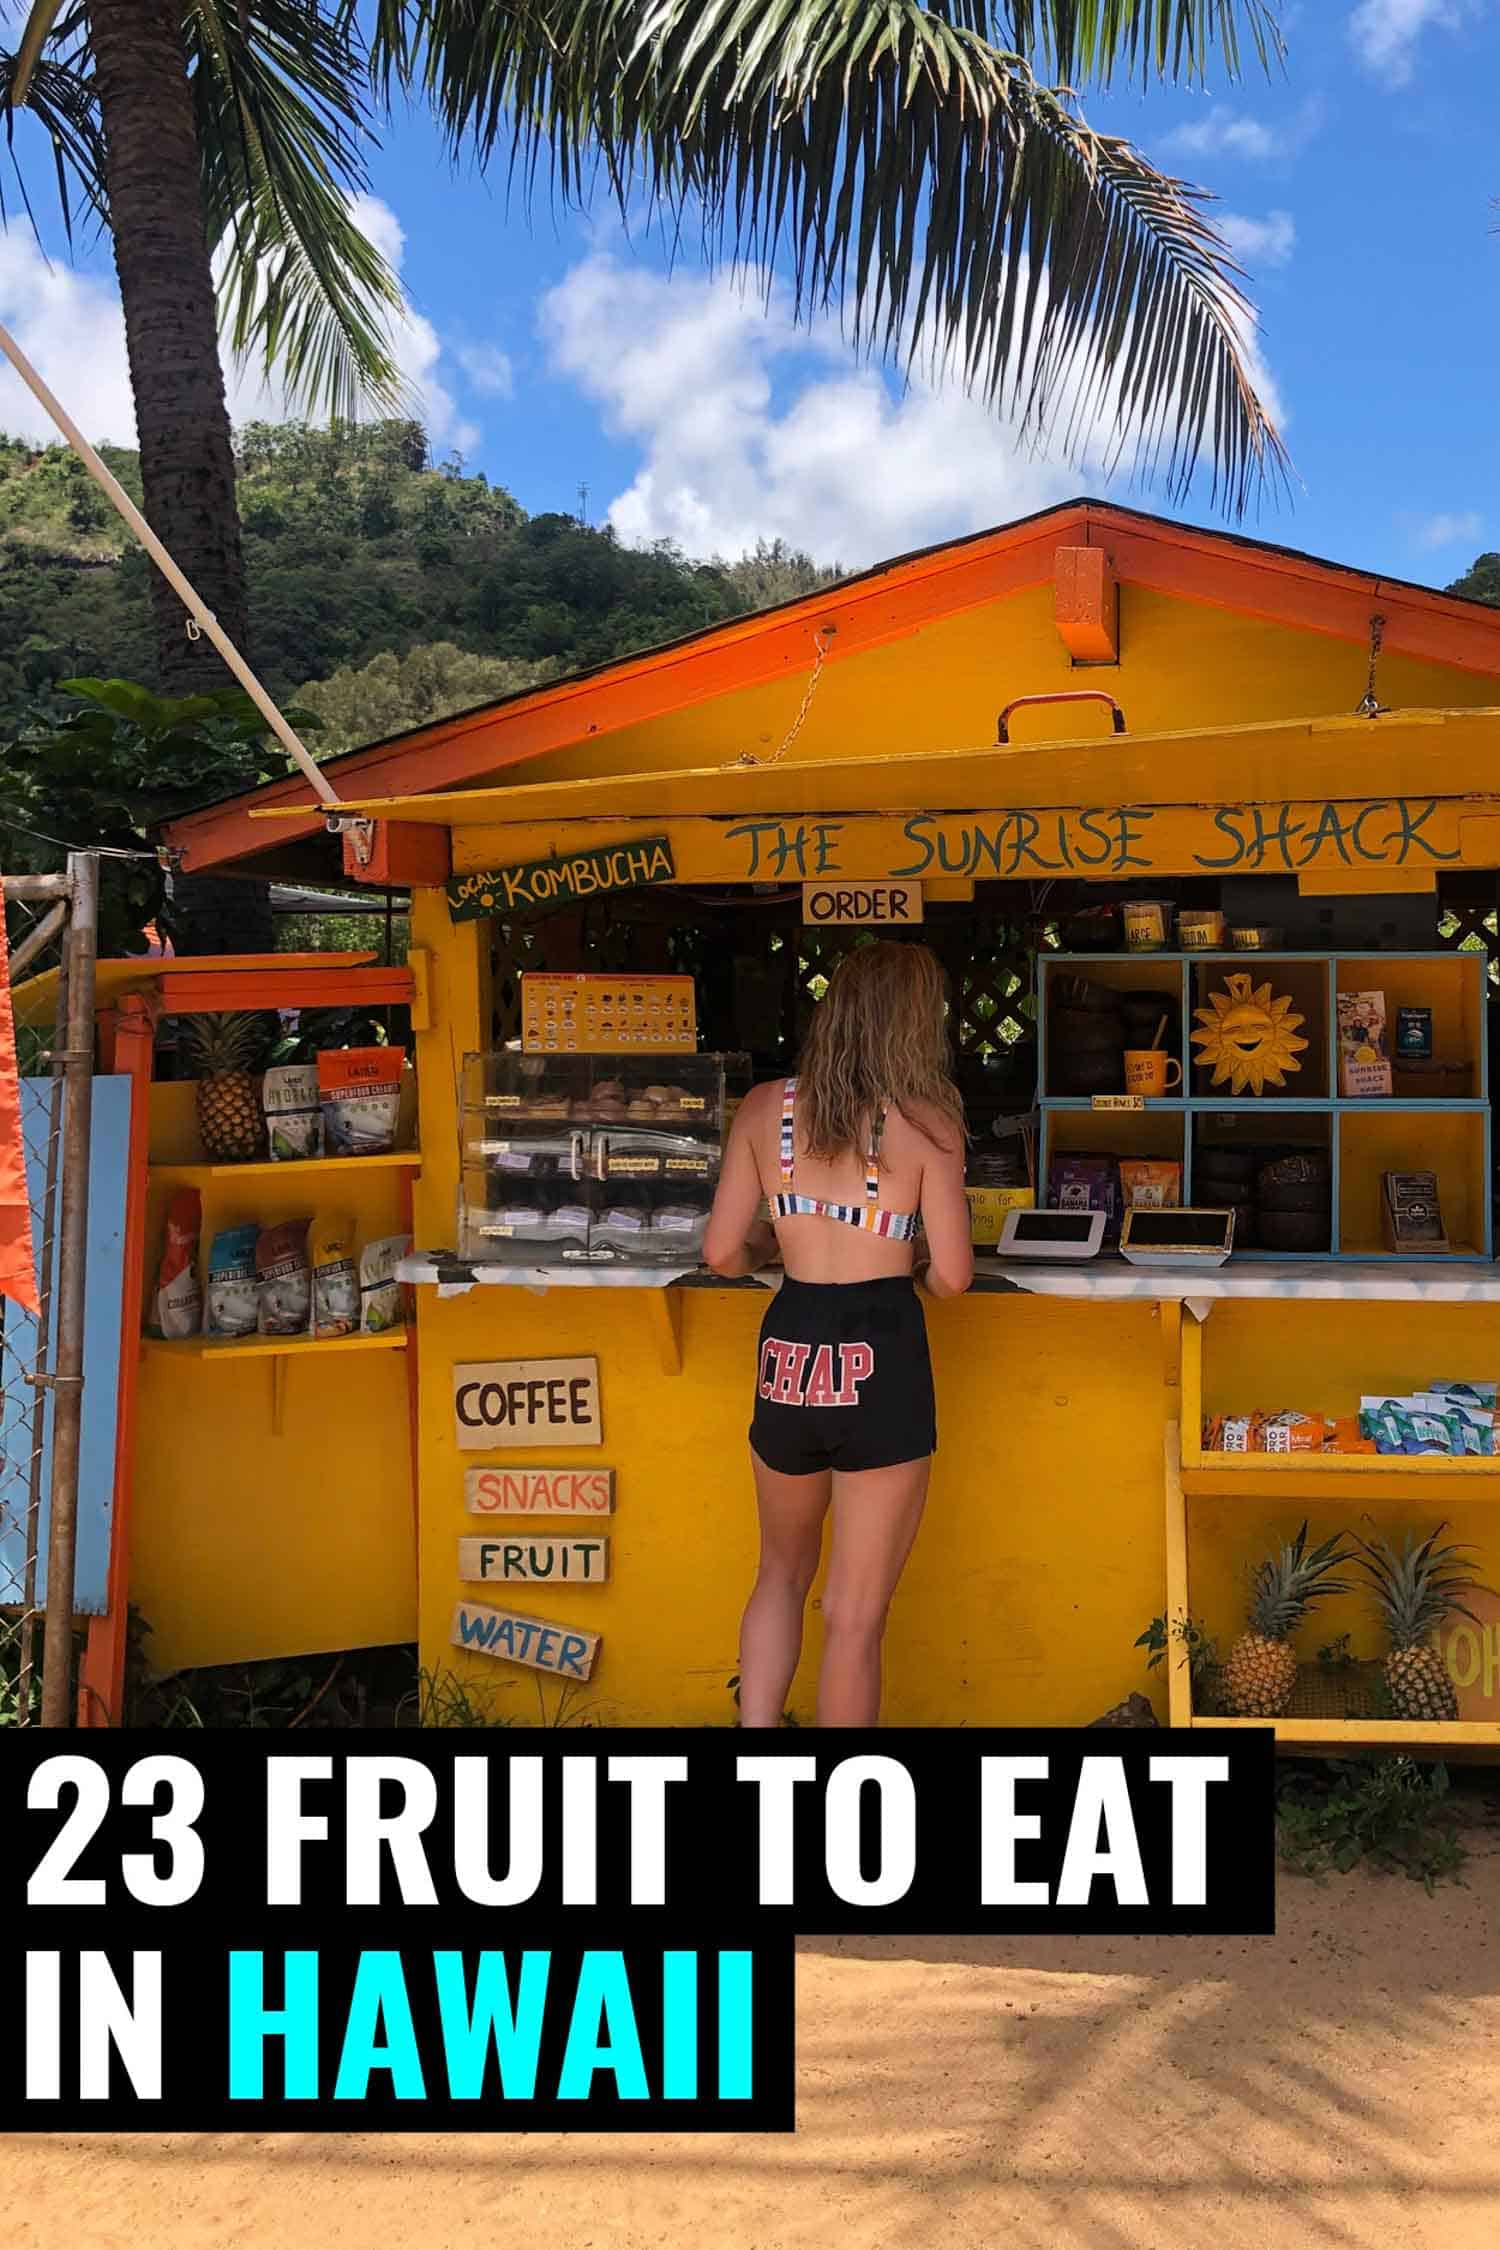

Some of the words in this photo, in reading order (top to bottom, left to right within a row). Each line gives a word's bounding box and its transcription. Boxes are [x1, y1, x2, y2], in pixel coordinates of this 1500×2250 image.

[725, 822, 844, 877] THE
[888, 809, 1153, 877] SUNRISE
[1193, 799, 1461, 868] SHACK
[448, 871, 501, 908] LOCAL
[502, 845, 673, 907] KOMBUCHA
[809, 889, 909, 920] ORDER
[760, 1337, 874, 1407] CHAP
[456, 1379, 593, 1426] COFFEE
[477, 1474, 609, 1511] SNACKS
[480, 1544, 600, 1579] FRUIT
[459, 1609, 588, 1677] WATER
